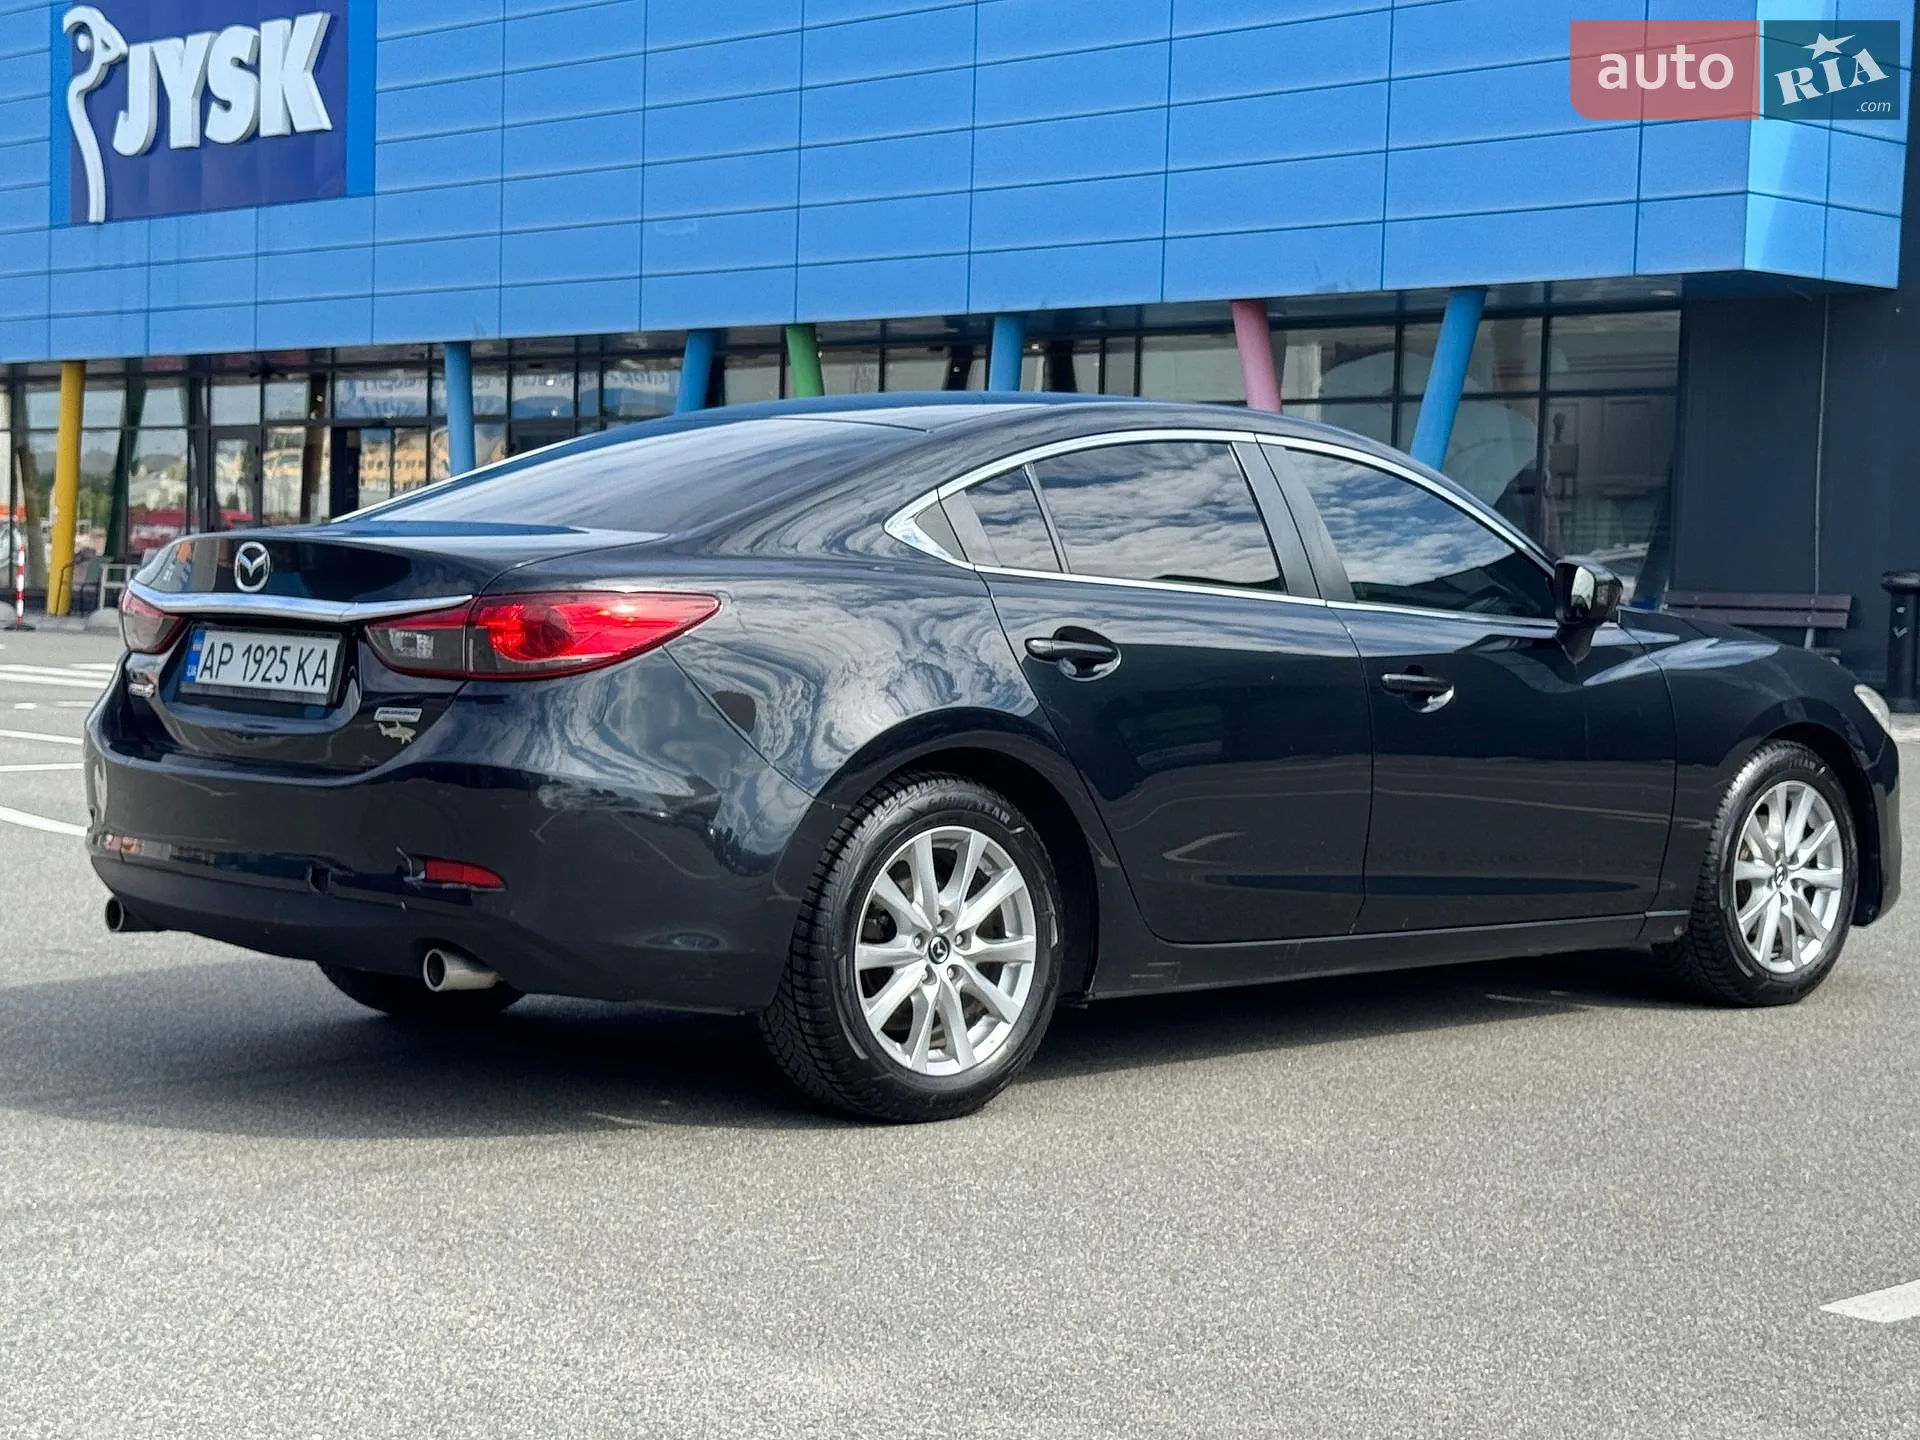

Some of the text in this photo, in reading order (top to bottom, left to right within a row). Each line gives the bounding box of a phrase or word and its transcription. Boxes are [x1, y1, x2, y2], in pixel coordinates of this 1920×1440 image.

[113, 13, 333, 157] JYSK
[199, 641, 329, 688] AP 1925 KA
